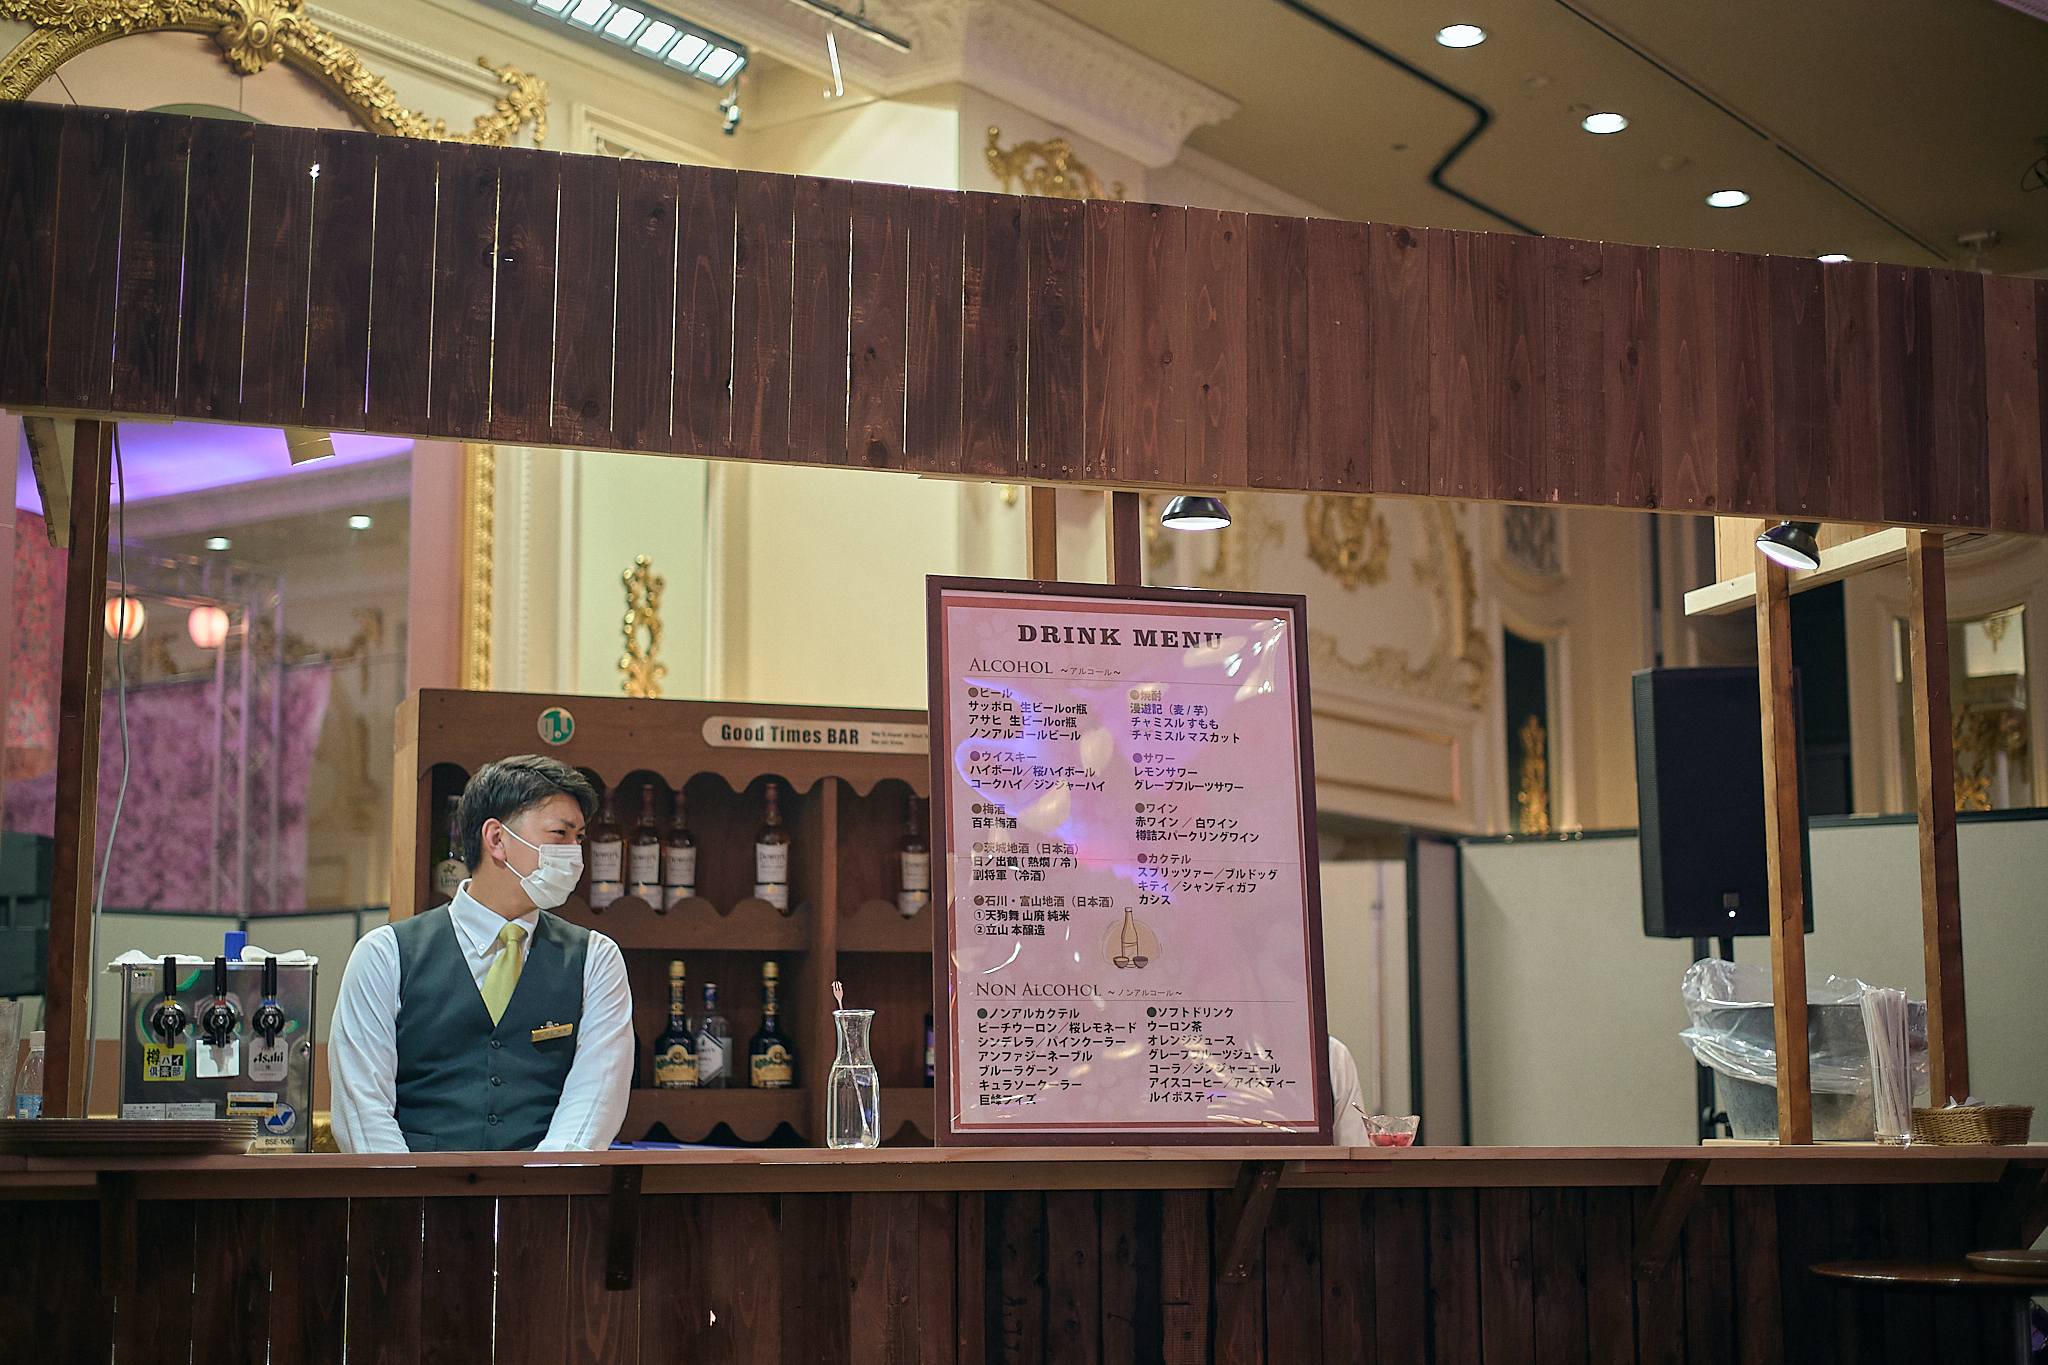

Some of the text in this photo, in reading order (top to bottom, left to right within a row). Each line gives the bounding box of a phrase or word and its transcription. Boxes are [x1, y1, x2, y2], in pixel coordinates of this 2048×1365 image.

[1017, 624, 1222, 650] DRINK MENU
[968, 657, 1054, 674] ALCOHOL
[981, 688, 1013, 698] ビール
[968, 715, 1002, 726] アサヒ
[1131, 717, 1219, 730] チャミスル すもも
[721, 724, 859, 745] Good Times BAR
[969, 728, 1081, 741] ノンアルコールビール
[1131, 730, 1240, 744] チャミスル マスカット
[981, 751, 1037, 762] ウイスキー
[1143, 753, 1176, 764] サワー
[1134, 766, 1198, 778] レモンサワー
[1134, 779, 1244, 792] グレープフルーツサワー
[982, 803, 1006, 815] 梅酒
[1146, 803, 1178, 814] ワイン
[972, 817, 1017, 829] 百年梅酒
[1149, 854, 1191, 865] カクテル
[1139, 894, 1171, 906] カシス
[976, 982, 1016, 996] NON
[1022, 982, 1102, 996] ALCOHOL
[989, 1008, 1080, 1019] ノンアルカクテル
[1158, 1007, 1234, 1018] ソフトドリンク
[1147, 1021, 1202, 1033] ウーロン茶
[1148, 1035, 1236, 1046] オレンジジュース
[253, 1051, 284, 1063] Asahi
[978, 1050, 1093, 1062] アンファジーネーブル
[979, 1065, 1059, 1077] ブルーラグーン
[979, 1079, 1082, 1091] キュラソークーラー
[1150, 1091, 1227, 1103] ルイボスティー
